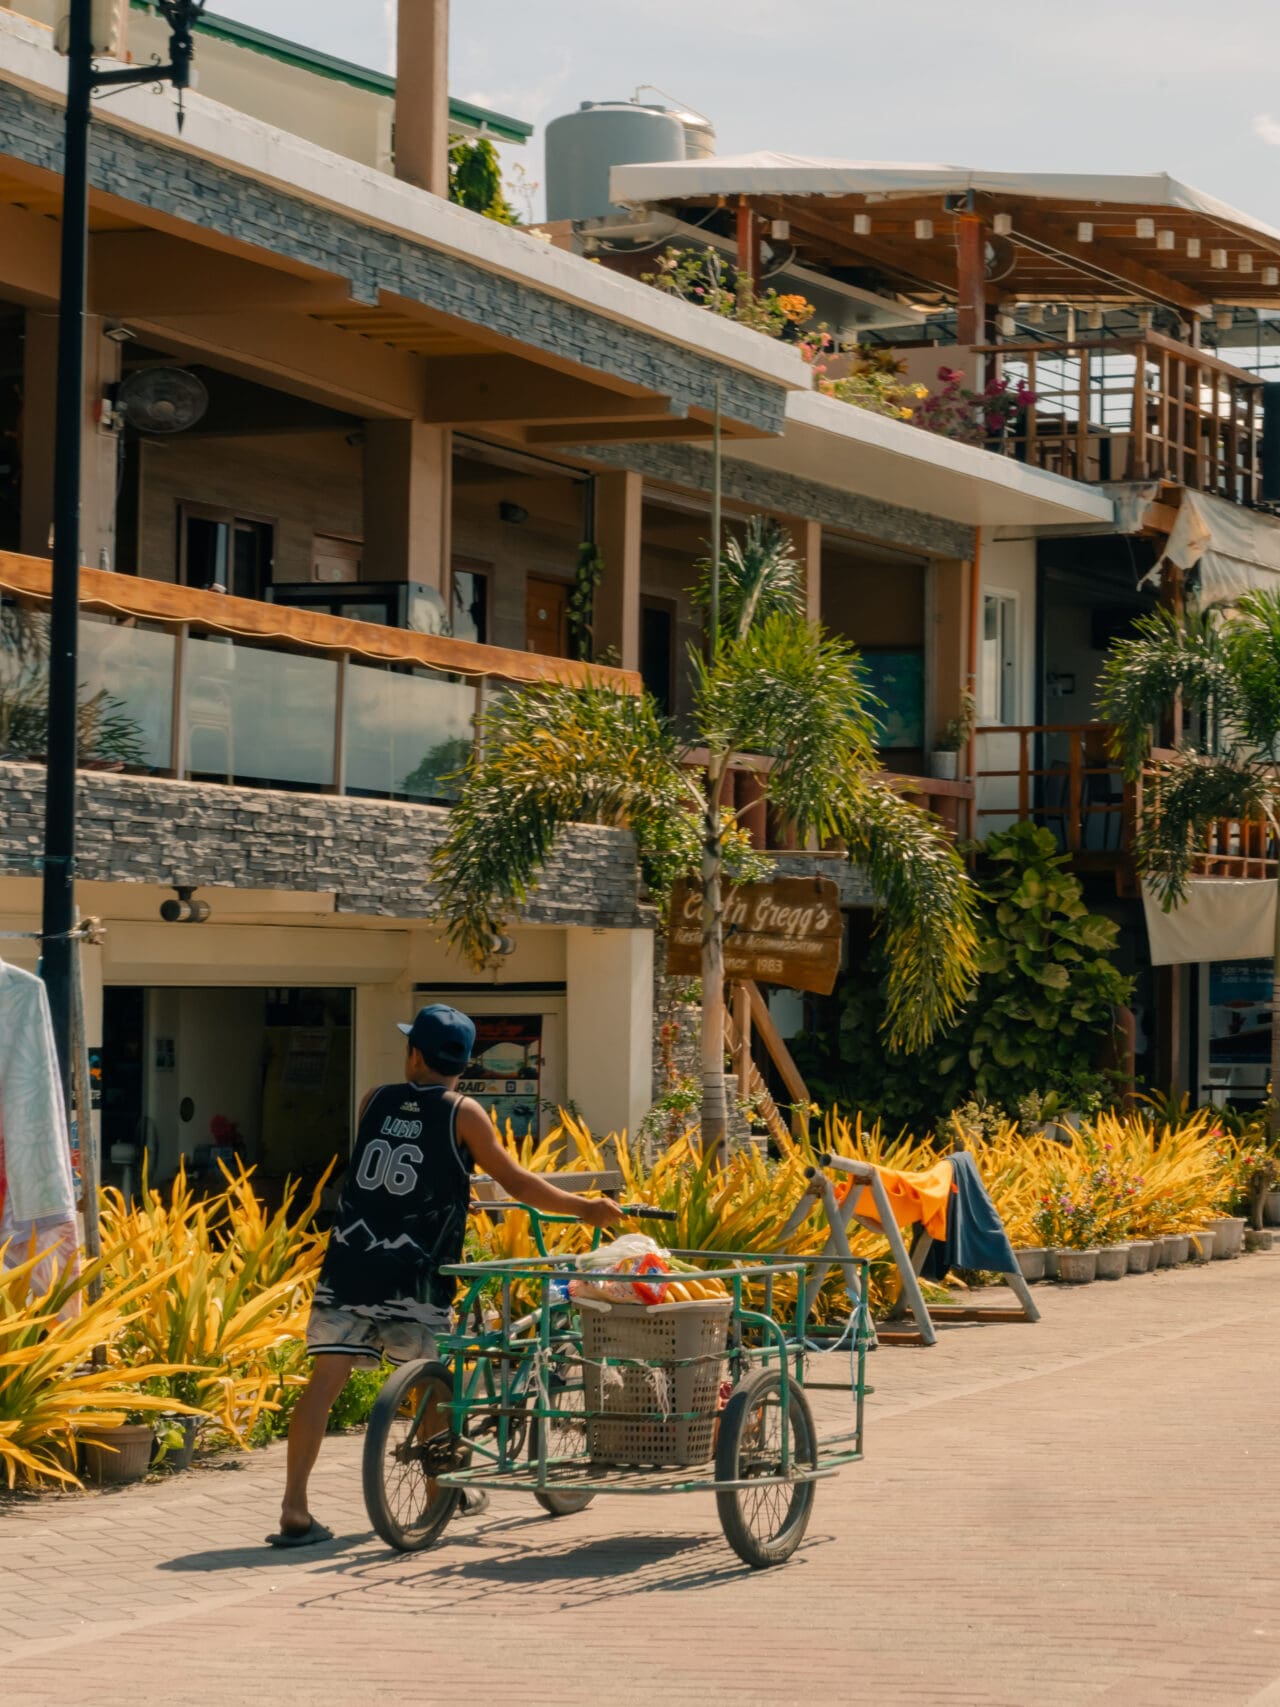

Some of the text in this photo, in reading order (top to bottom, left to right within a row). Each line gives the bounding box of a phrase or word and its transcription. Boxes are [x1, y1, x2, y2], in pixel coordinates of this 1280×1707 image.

[752, 897, 832, 940] Gregg's
[756, 958, 784, 974] 1983
[355, 1138, 424, 1196] 06
